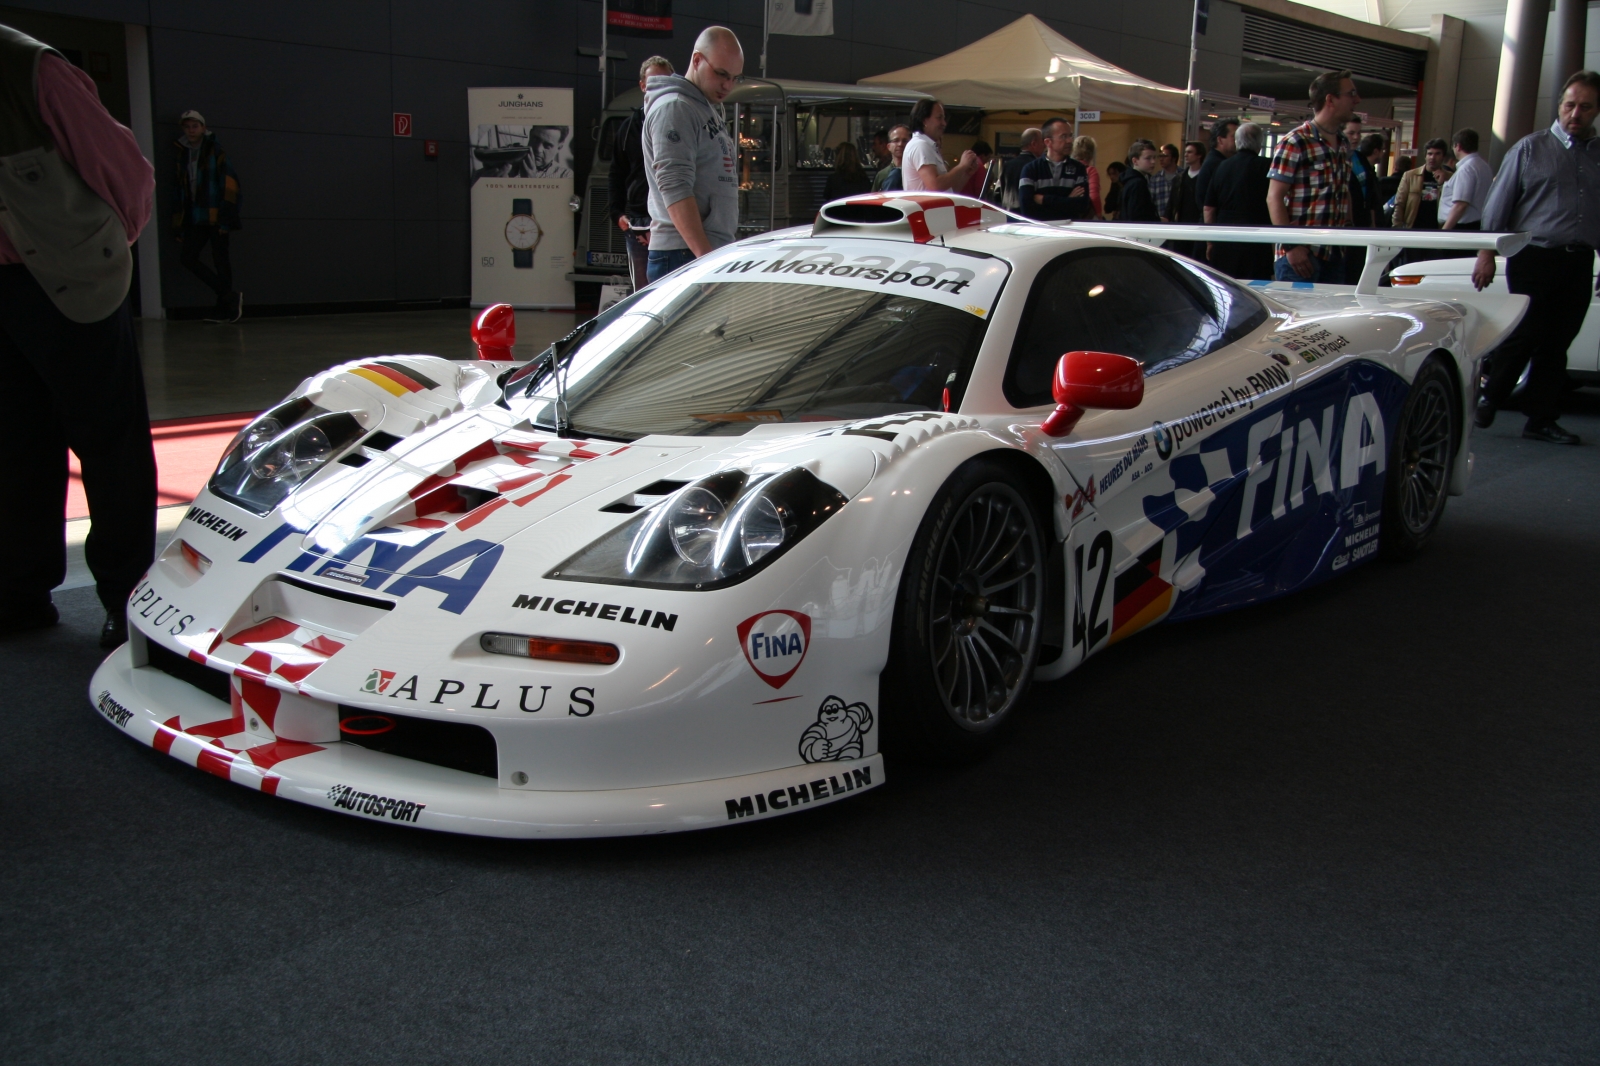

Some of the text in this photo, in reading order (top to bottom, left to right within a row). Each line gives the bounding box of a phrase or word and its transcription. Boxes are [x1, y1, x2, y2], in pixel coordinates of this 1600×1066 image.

[592, 254, 599, 262] ES
[761, 259, 970, 295] Motorsport
[764, 245, 976, 292] Team
[1302, 329, 1332, 343] Soper
[1318, 335, 1350, 354] Piquet
[1172, 362, 1290, 450] powered by BMW
[1072, 434, 1148, 522] 24 HEURES DU MANS
[1237, 392, 1386, 540] FINA
[186, 506, 248, 542] MICHELIN
[1345, 523, 1380, 548] MICHELIN
[918, 496, 952, 601] MICHELIN
[130, 580, 196, 636] APLUS
[511, 594, 678, 632] MICHELIN
[1072, 530, 1112, 662] 42
[751, 632, 802, 660] FINA
[389, 675, 595, 717] APLUS
[334, 786, 426, 822] AUTOSPORT
[724, 766, 872, 820] MICHELIN
